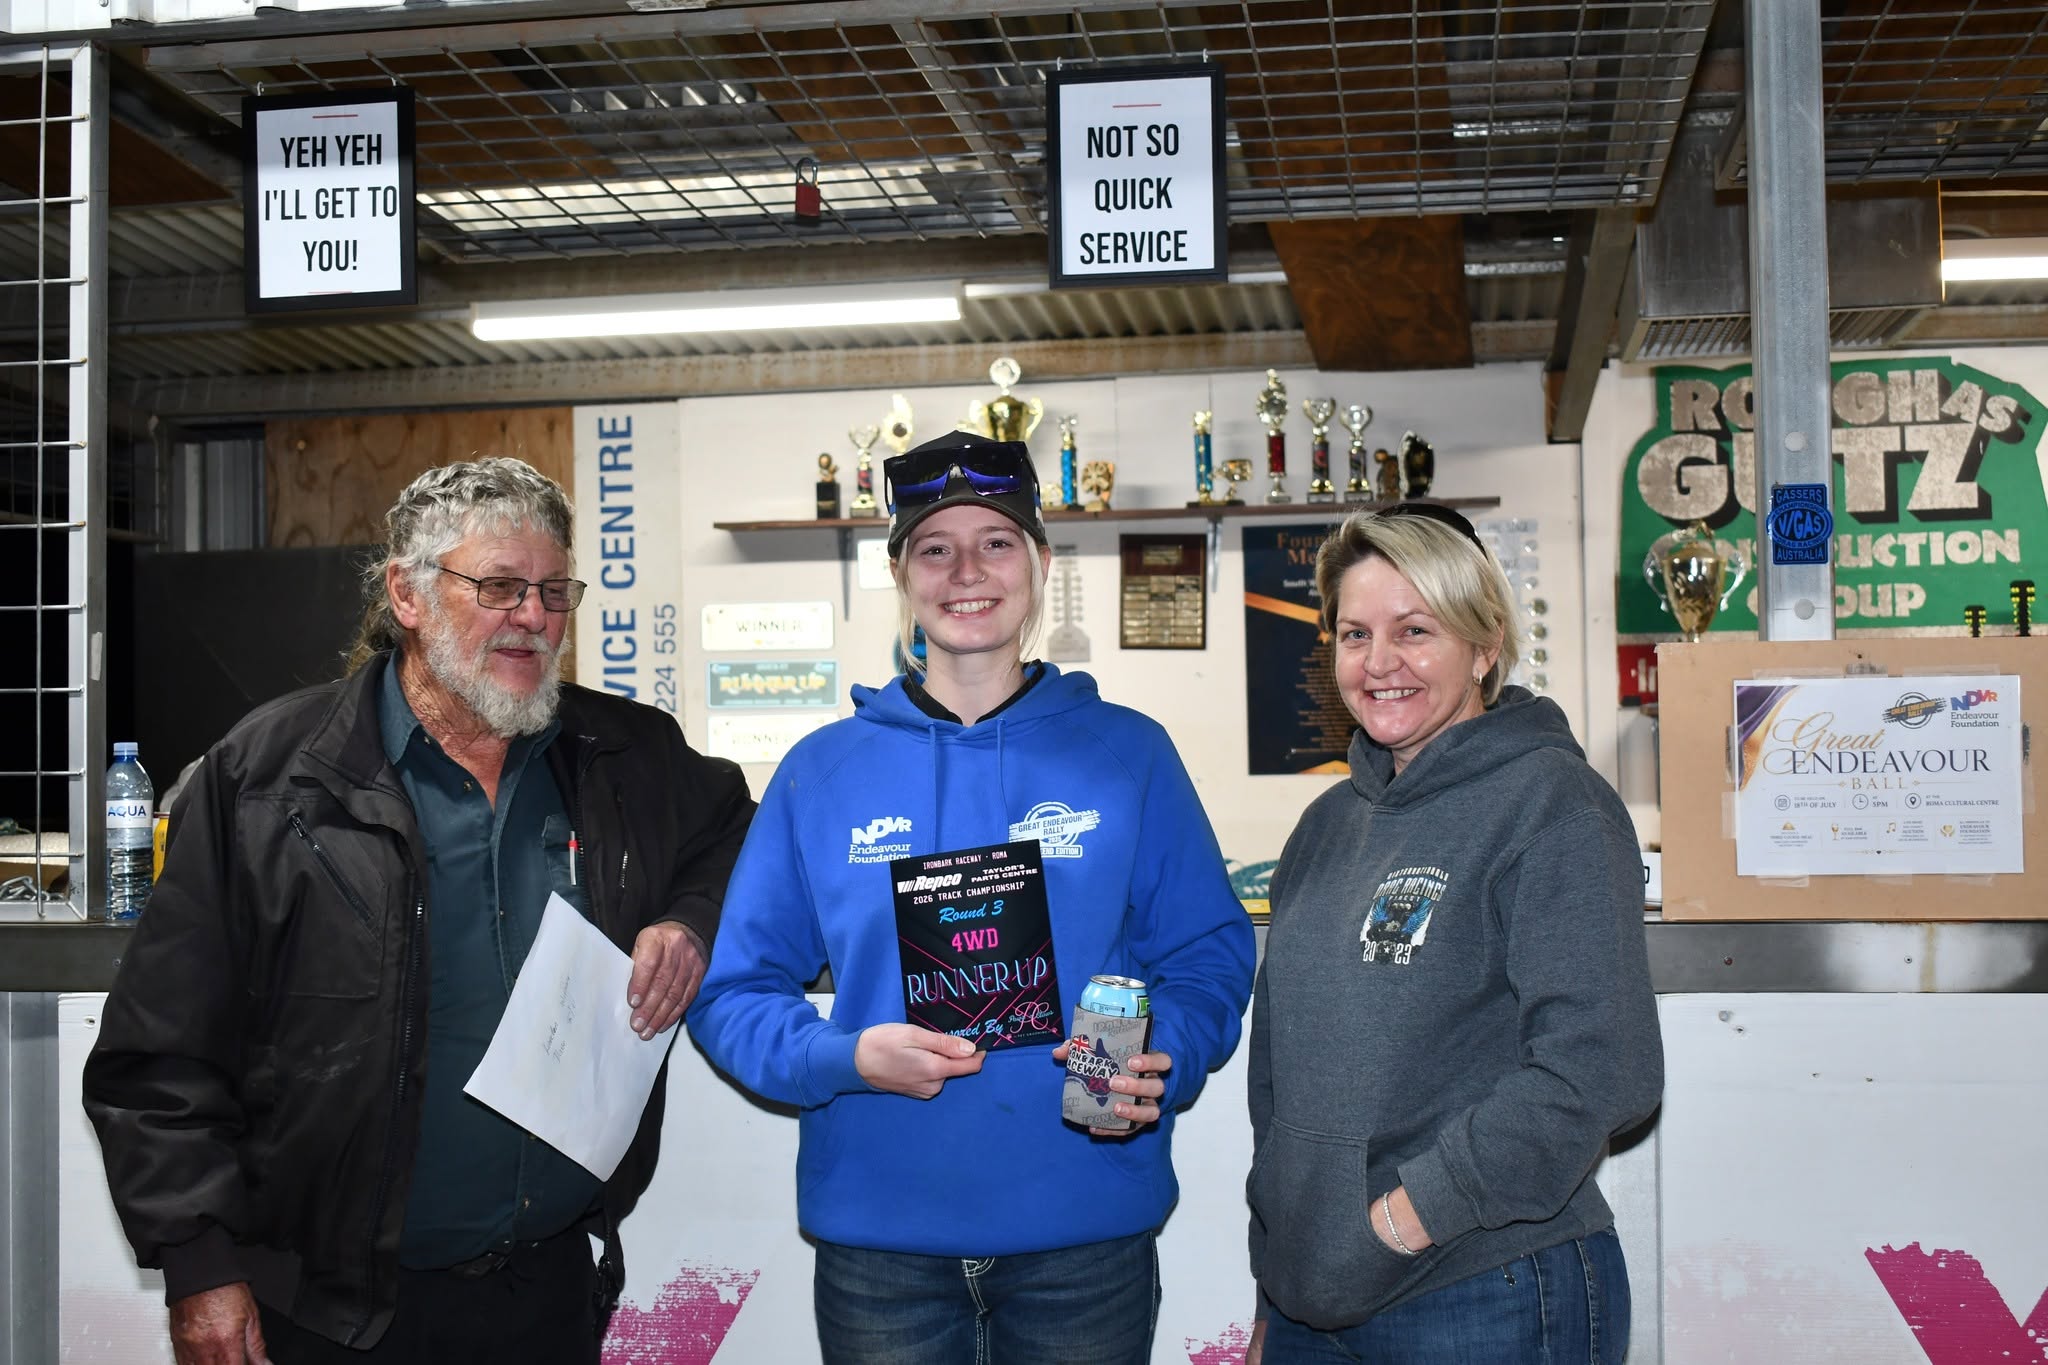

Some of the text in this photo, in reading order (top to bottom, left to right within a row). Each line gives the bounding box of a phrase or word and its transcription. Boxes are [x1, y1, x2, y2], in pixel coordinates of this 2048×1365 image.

[280, 133, 382, 168] YEH YEH
[1087, 124, 1179, 158] NOT SO
[264, 185, 397, 221] I'LL GET TO
[1095, 177, 1172, 213] QUICK
[302, 239, 358, 272] YOU!
[1080, 230, 1187, 264] SERVICE
[1670, 369, 1940, 432] ROGH
[1637, 424, 1979, 520] GTZ
[1776, 488, 1822, 503] GASSERS
[598, 416, 638, 699] VICE CENTRE
[1777, 548, 1824, 560] AUSTRALIA
[654, 604, 677, 713] 224 555
[1950, 711, 1999, 720] Endeavour
[1950, 719, 1999, 728] Foundation
[1772, 711, 1886, 751] Great
[1790, 749, 1991, 775] ENDEAVOUR
[1851, 777, 1908, 790] BALL
[107, 805, 147, 817] AQUA
[1018, 815, 1083, 833] GREAT ENDEAVOUR
[1043, 826, 1064, 837] RALLY
[848, 853, 910, 863] Foundation
[849, 843, 911, 854] Endeavour
[1056, 847, 1080, 856] EDITION
[923, 851, 1008, 871] IRONBARK RACEWAY ROMA
[983, 864, 1025, 875] TAYLOR'S
[913, 873, 963, 892] Repco
[971, 868, 1038, 883] PARTS CENTRE
[913, 881, 1025, 905] 2026 TRACK CHAMPIONSHIP
[939, 899, 1005, 924] Round 3
[951, 928, 999, 952] 4WD
[1363, 941, 1412, 964] 20 23
[907, 956, 1047, 1004] RUNNER UP
[944, 1018, 1004, 1037] sored By
[1070, 1047, 1113, 1068] ONBARK
[1067, 1060, 1119, 1079] ACEWAY
